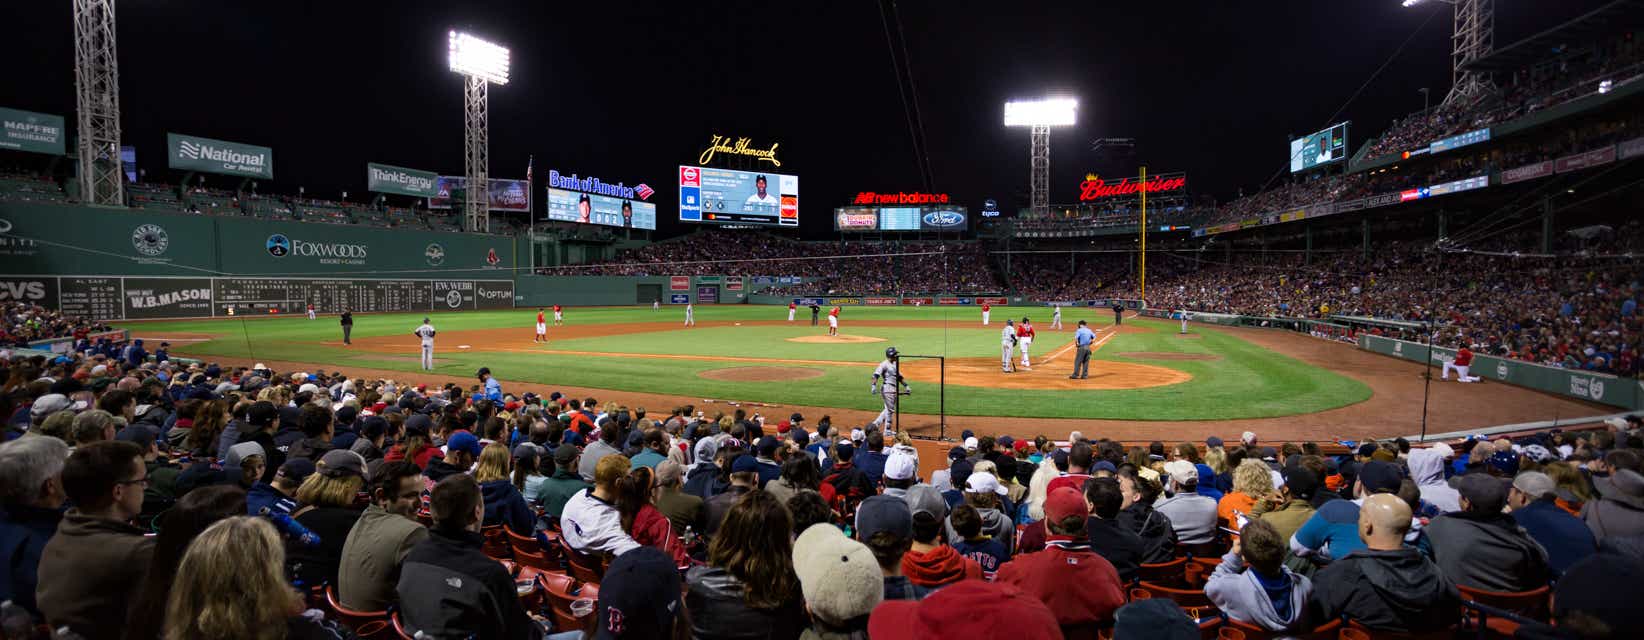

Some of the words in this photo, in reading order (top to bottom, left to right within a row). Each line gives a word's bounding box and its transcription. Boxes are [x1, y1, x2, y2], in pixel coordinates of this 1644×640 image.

[4, 120, 58, 135] MAPFRE
[8, 131, 57, 143] INSURANCE
[200, 145, 265, 166] National
[699, 134, 734, 165] John
[732, 136, 781, 167] Hancock
[238, 164, 263, 173] Rental
[549, 169, 581, 190] Bank
[580, 176, 593, 192] of
[593, 178, 634, 199] America
[1080, 175, 1185, 201] Budweiser
[875, 193, 899, 204] new
[899, 192, 949, 204] balance
[931, 211, 956, 224] Ford
[292, 240, 368, 258] FOXWOODS
[0, 281, 45, 300] CVS
[486, 290, 512, 299] OPTUM
[227, 307, 235, 316] 5
[1570, 383, 1589, 397] Nine
[607, 605, 623, 633] B
